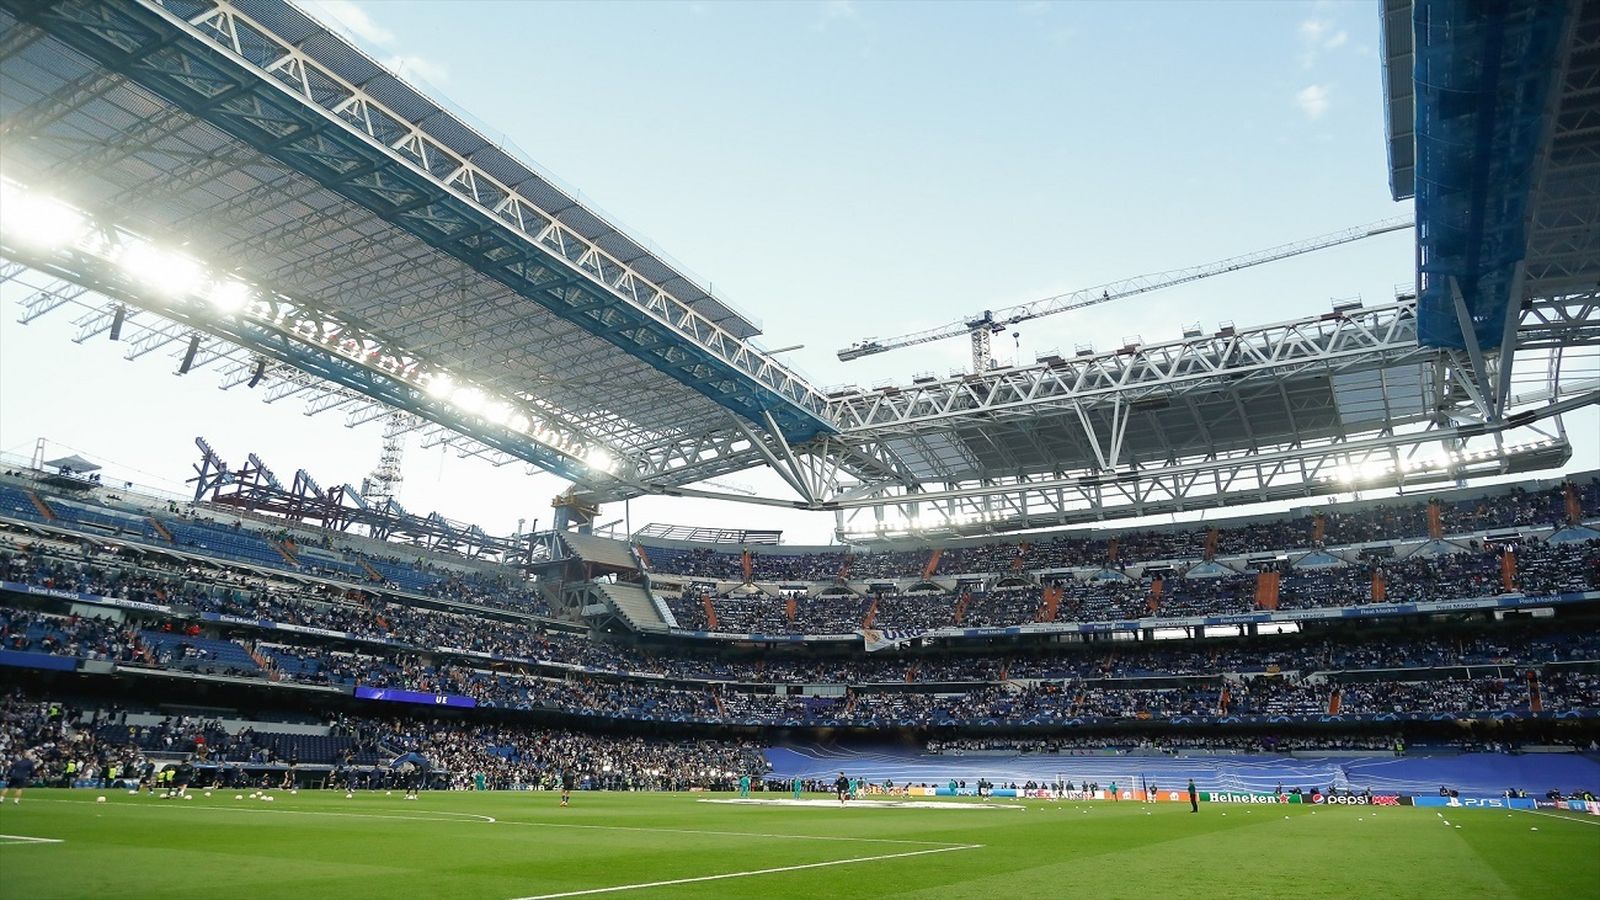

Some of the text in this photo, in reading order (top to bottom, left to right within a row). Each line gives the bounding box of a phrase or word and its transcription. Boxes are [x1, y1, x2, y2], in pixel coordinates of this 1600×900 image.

[29, 586, 79, 599] Real Madrid
[1537, 594, 1562, 602] Madrid
[133, 602, 159, 610] Madrid
[1361, 605, 1399, 615] Real Madrid
[1453, 601, 1478, 610] Madrid
[435, 696, 448, 704] UE
[1209, 792, 1276, 804] Heineken
[1327, 794, 1369, 806] pepsi
[1464, 798, 1505, 808] PS5
